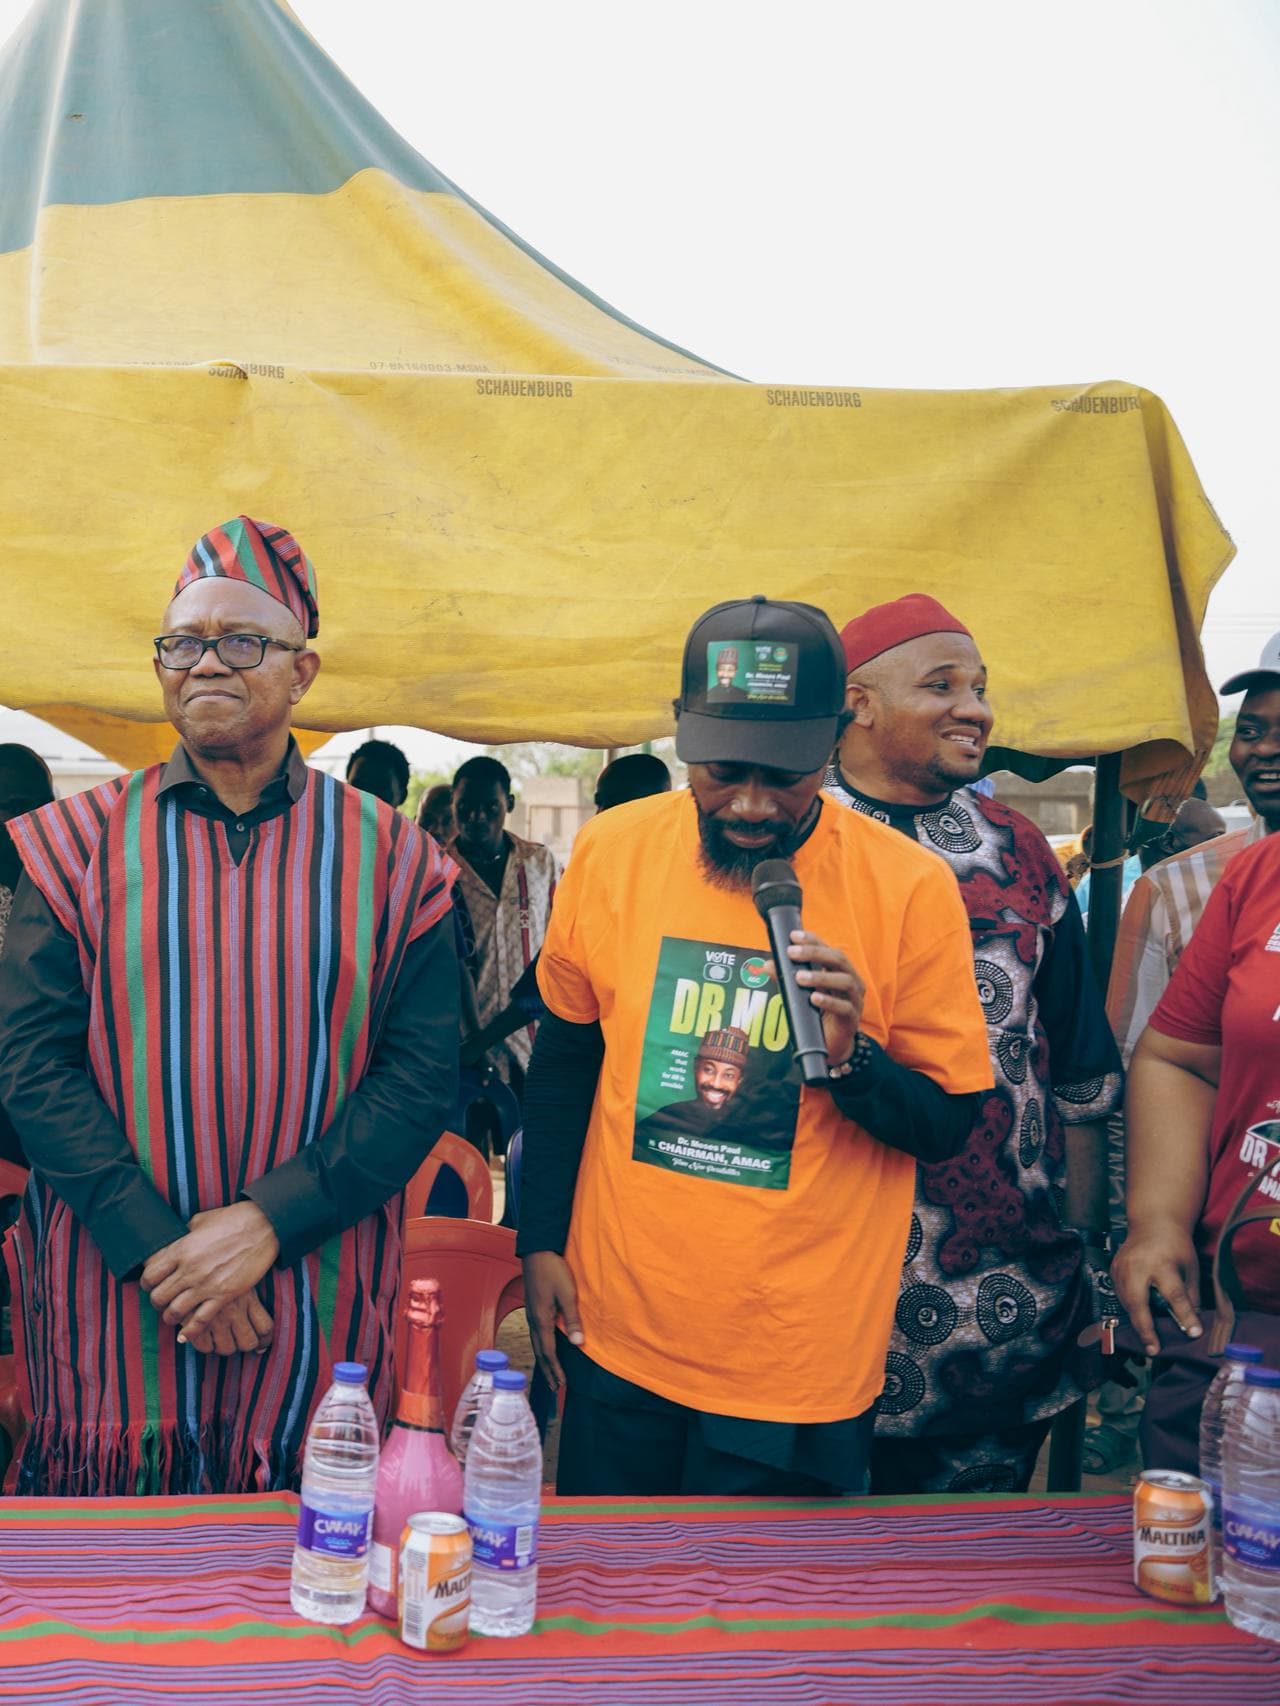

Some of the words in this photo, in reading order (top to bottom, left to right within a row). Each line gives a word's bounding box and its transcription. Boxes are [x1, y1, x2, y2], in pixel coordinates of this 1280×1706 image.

[476, 378, 573, 398] SCHAUENBURG
[766, 388, 862, 408] SCHAUENBURG
[705, 950, 736, 965] VOTE
[669, 978, 726, 1038] DR
[731, 987, 790, 1052] MO
[658, 1141, 728, 1165] CHAIRMAN,
[731, 1156, 771, 1169] AMAC
[677, 1137, 689, 1146] Dr.
[691, 1140, 719, 1151] Moses
[720, 1145, 741, 1154] Paul
[1239, 1133, 1268, 1168] DR
[314, 1519, 364, 1537] CWAY
[470, 1527, 507, 1548] WAY
[1140, 1526, 1206, 1546] MALTINA
